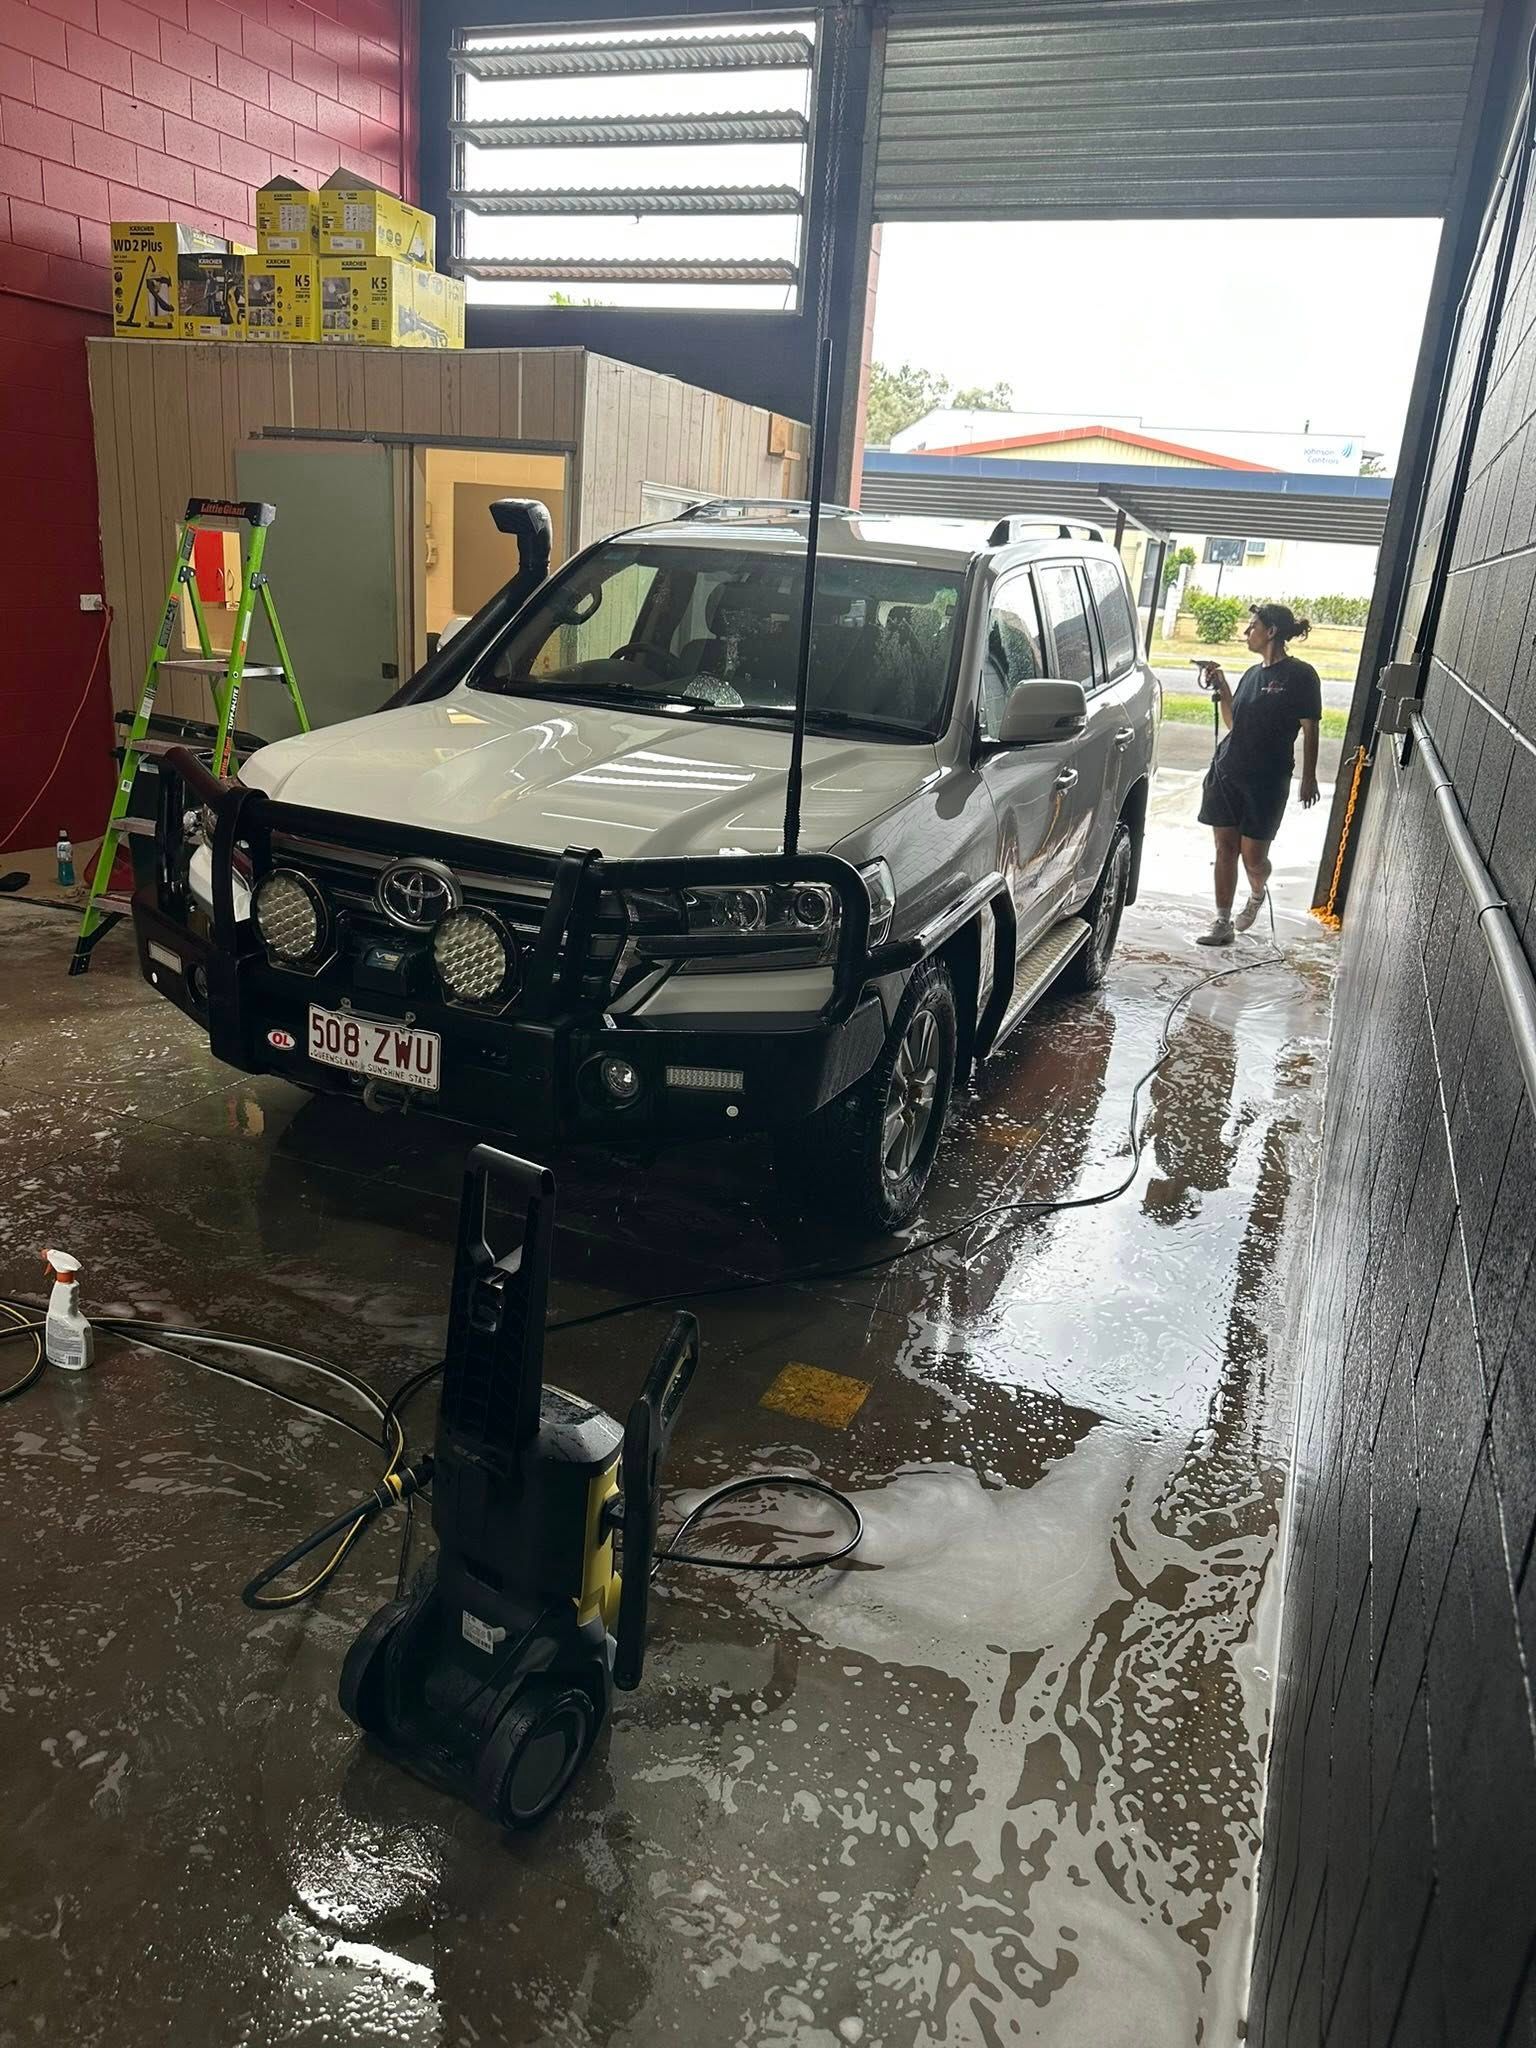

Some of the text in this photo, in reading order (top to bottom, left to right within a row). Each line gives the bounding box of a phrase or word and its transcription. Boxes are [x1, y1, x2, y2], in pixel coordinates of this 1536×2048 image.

[141, 239, 163, 252] Plus
[1304, 447, 1335, 456] Johnson
[201, 503, 246, 516] Little Giant
[272, 1032, 290, 1046] OL
[312, 1013, 433, 1075] 508 ZWU
[367, 1063, 405, 1080] SUNSHINE
[409, 1073, 433, 1087] STATE
